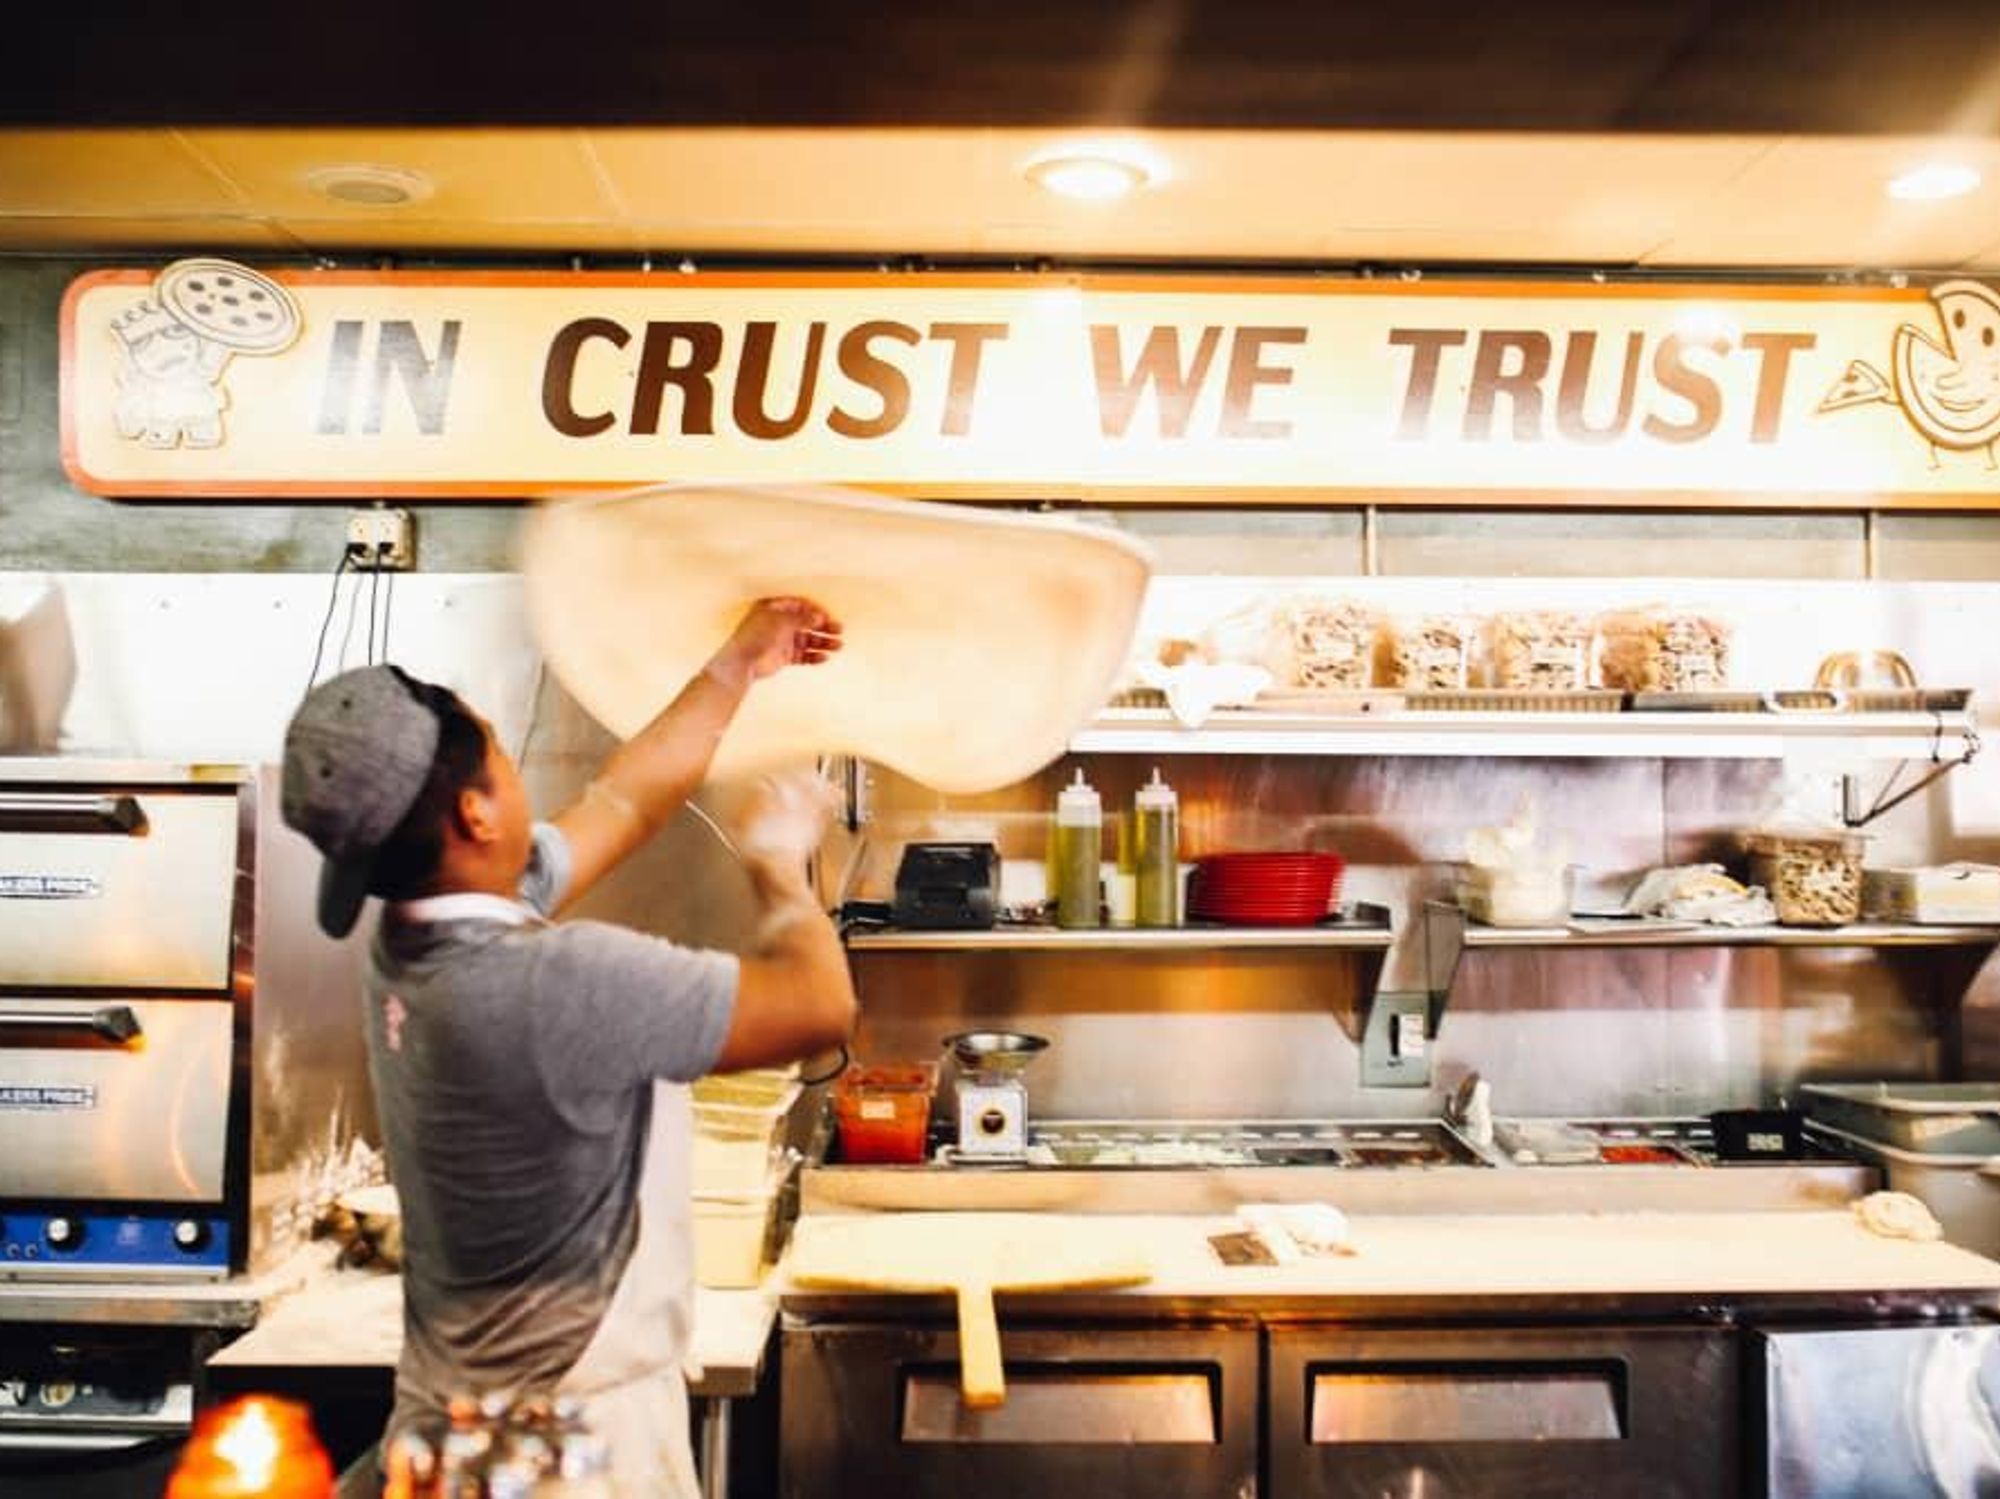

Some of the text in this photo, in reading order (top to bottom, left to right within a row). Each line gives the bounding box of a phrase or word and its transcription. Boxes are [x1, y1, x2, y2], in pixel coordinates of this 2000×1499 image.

[316, 317, 1817, 444] IN CRUST WE TRUST
